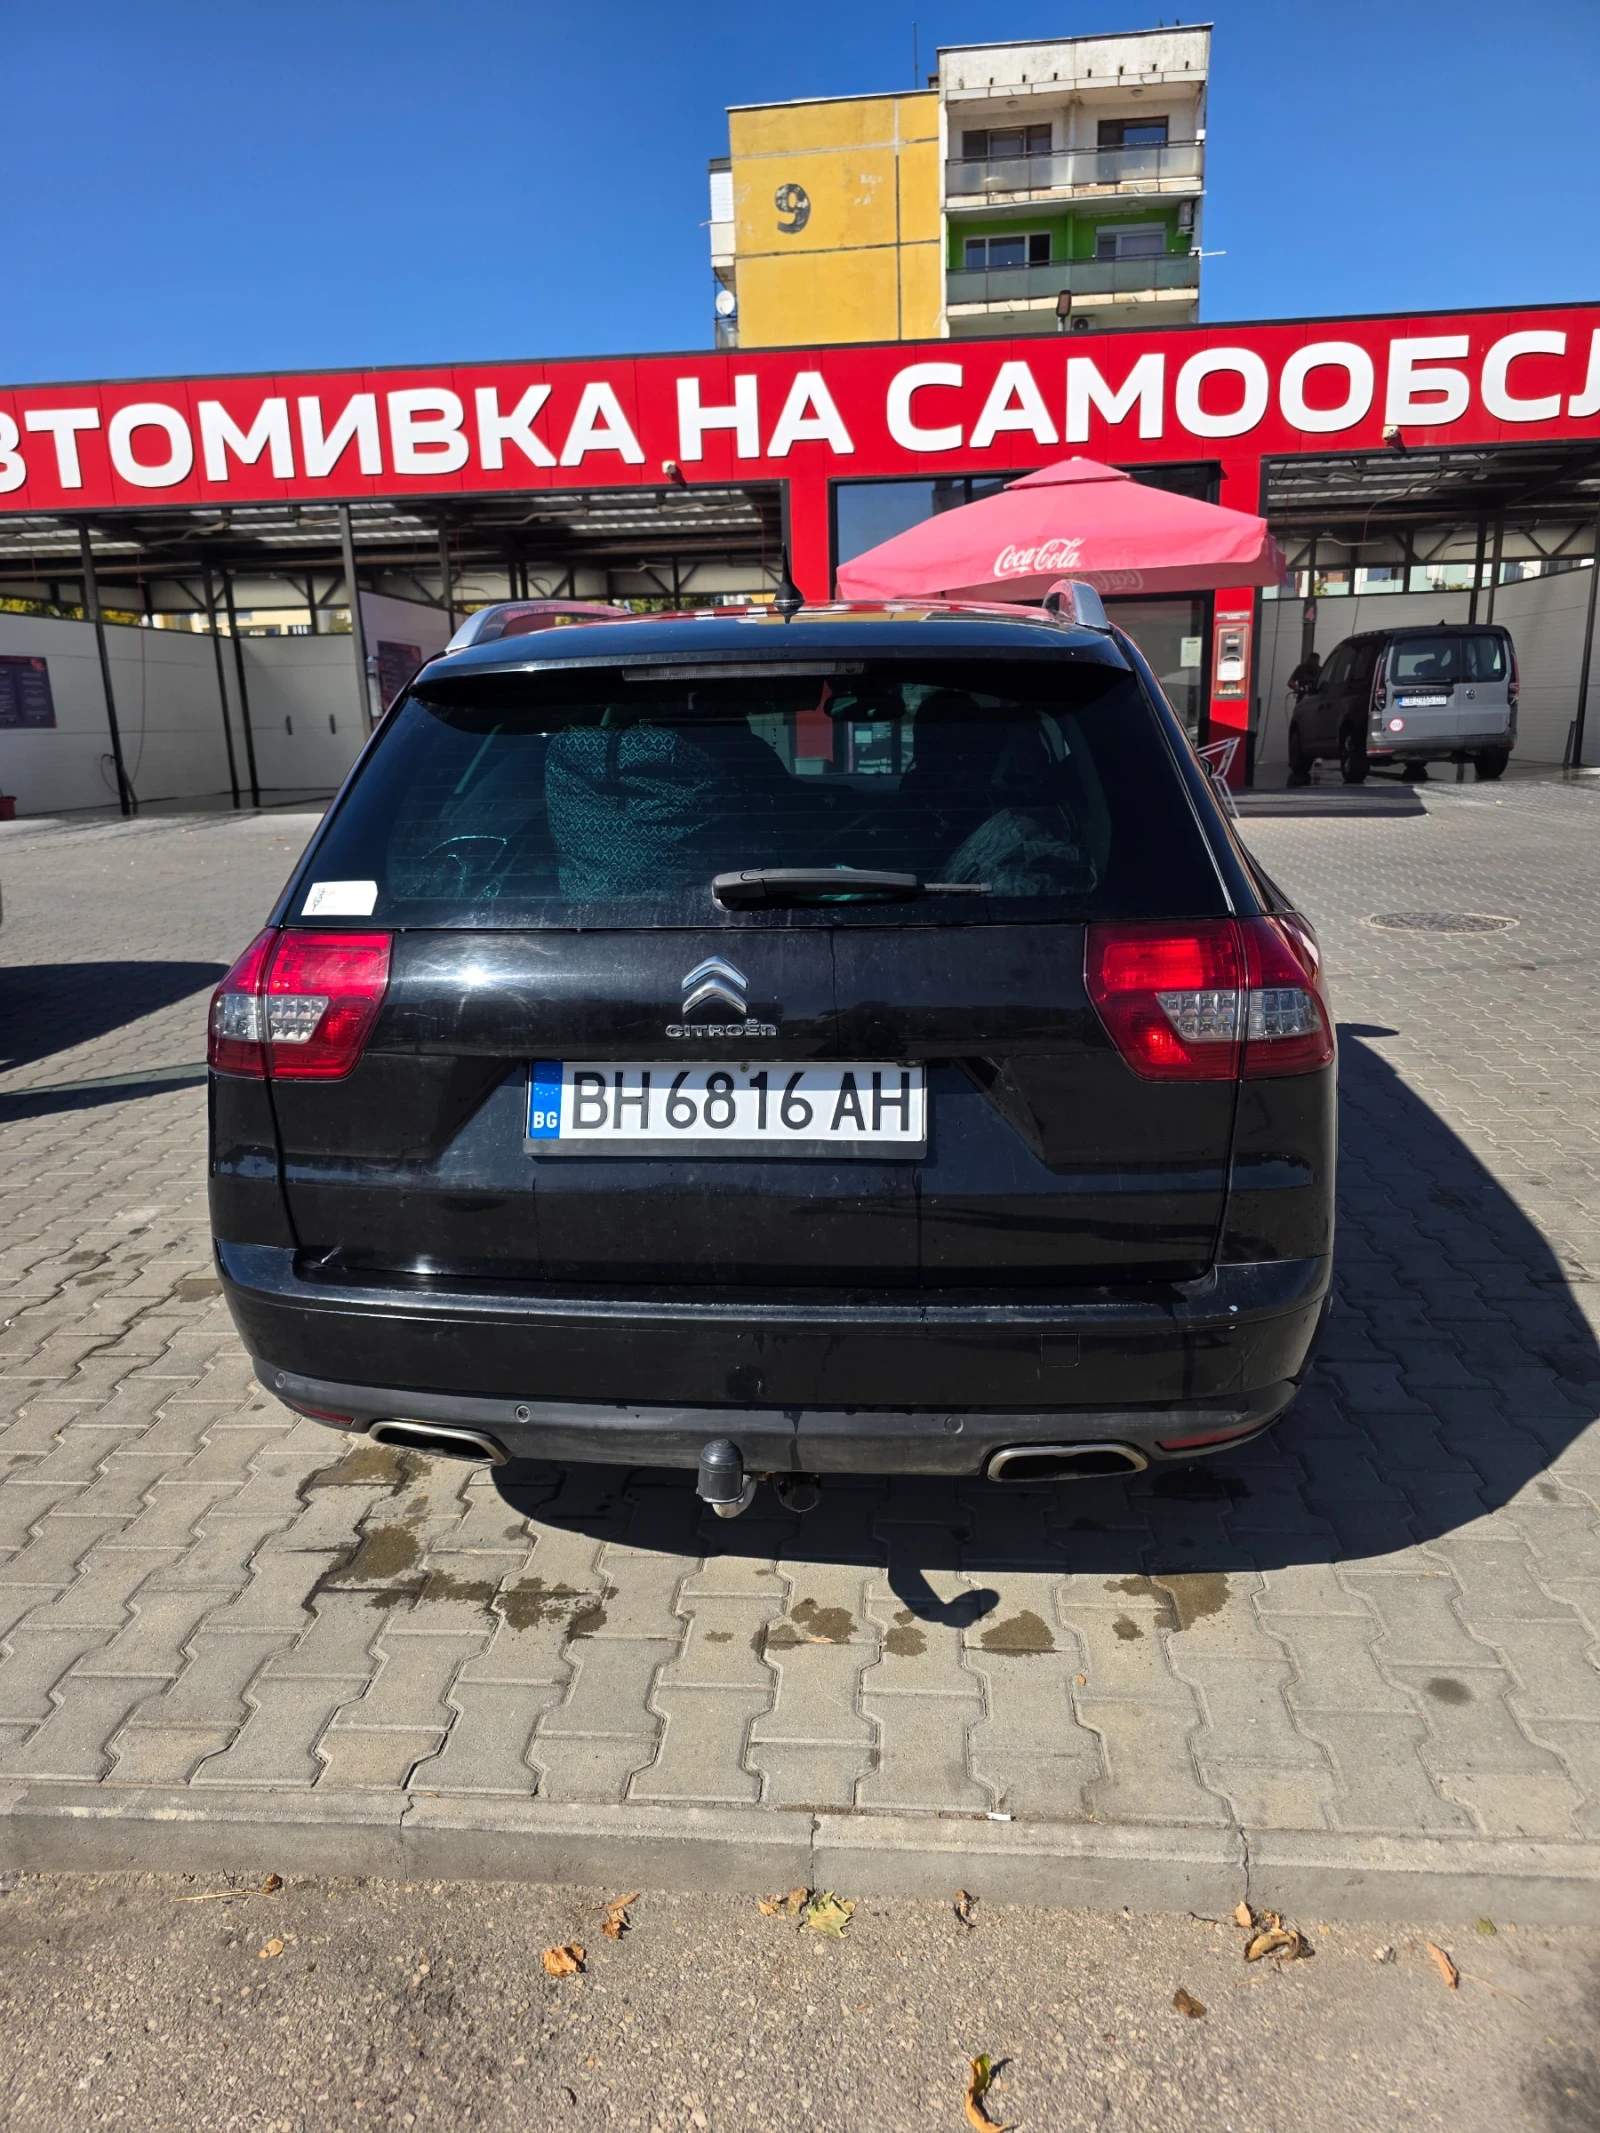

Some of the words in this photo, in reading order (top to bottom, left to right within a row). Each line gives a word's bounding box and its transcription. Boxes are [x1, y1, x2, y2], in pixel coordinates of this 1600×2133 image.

[774, 183, 811, 235] 9
[676, 371, 855, 461] НА
[993, 538, 1086, 577] Coca-Cola
[533, 1111, 558, 1129] BG
[572, 1071, 650, 1131] BH
[665, 1071, 814, 1131] 6816
[830, 1071, 910, 1132] AH
